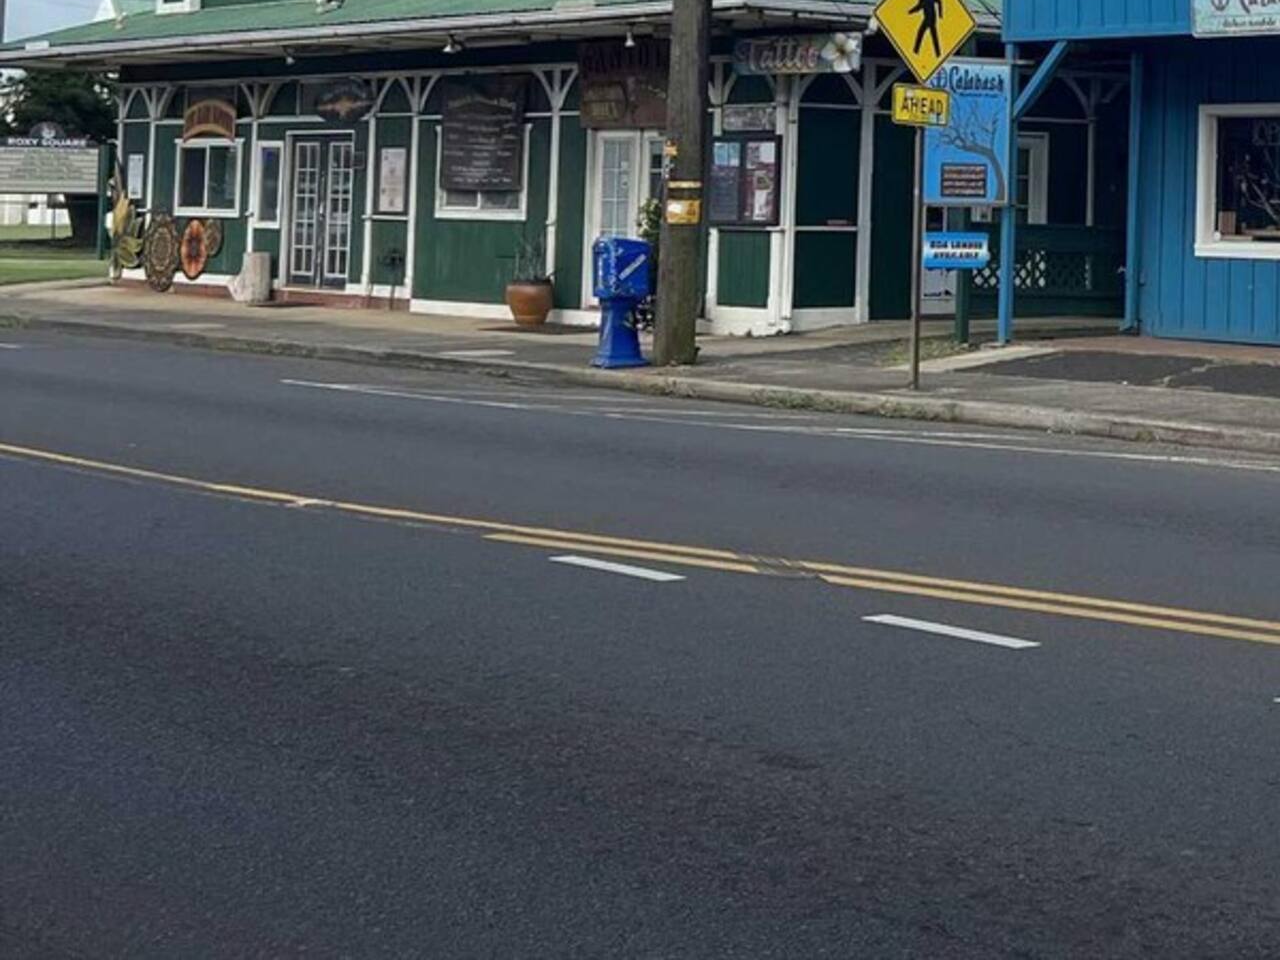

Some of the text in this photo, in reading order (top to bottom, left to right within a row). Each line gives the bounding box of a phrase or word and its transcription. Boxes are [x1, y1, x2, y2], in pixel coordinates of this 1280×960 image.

[949, 65, 1004, 94] Calabash
[901, 96, 944, 117] AHEAD
[7, 137, 87, 149] ROXY SQUARE
